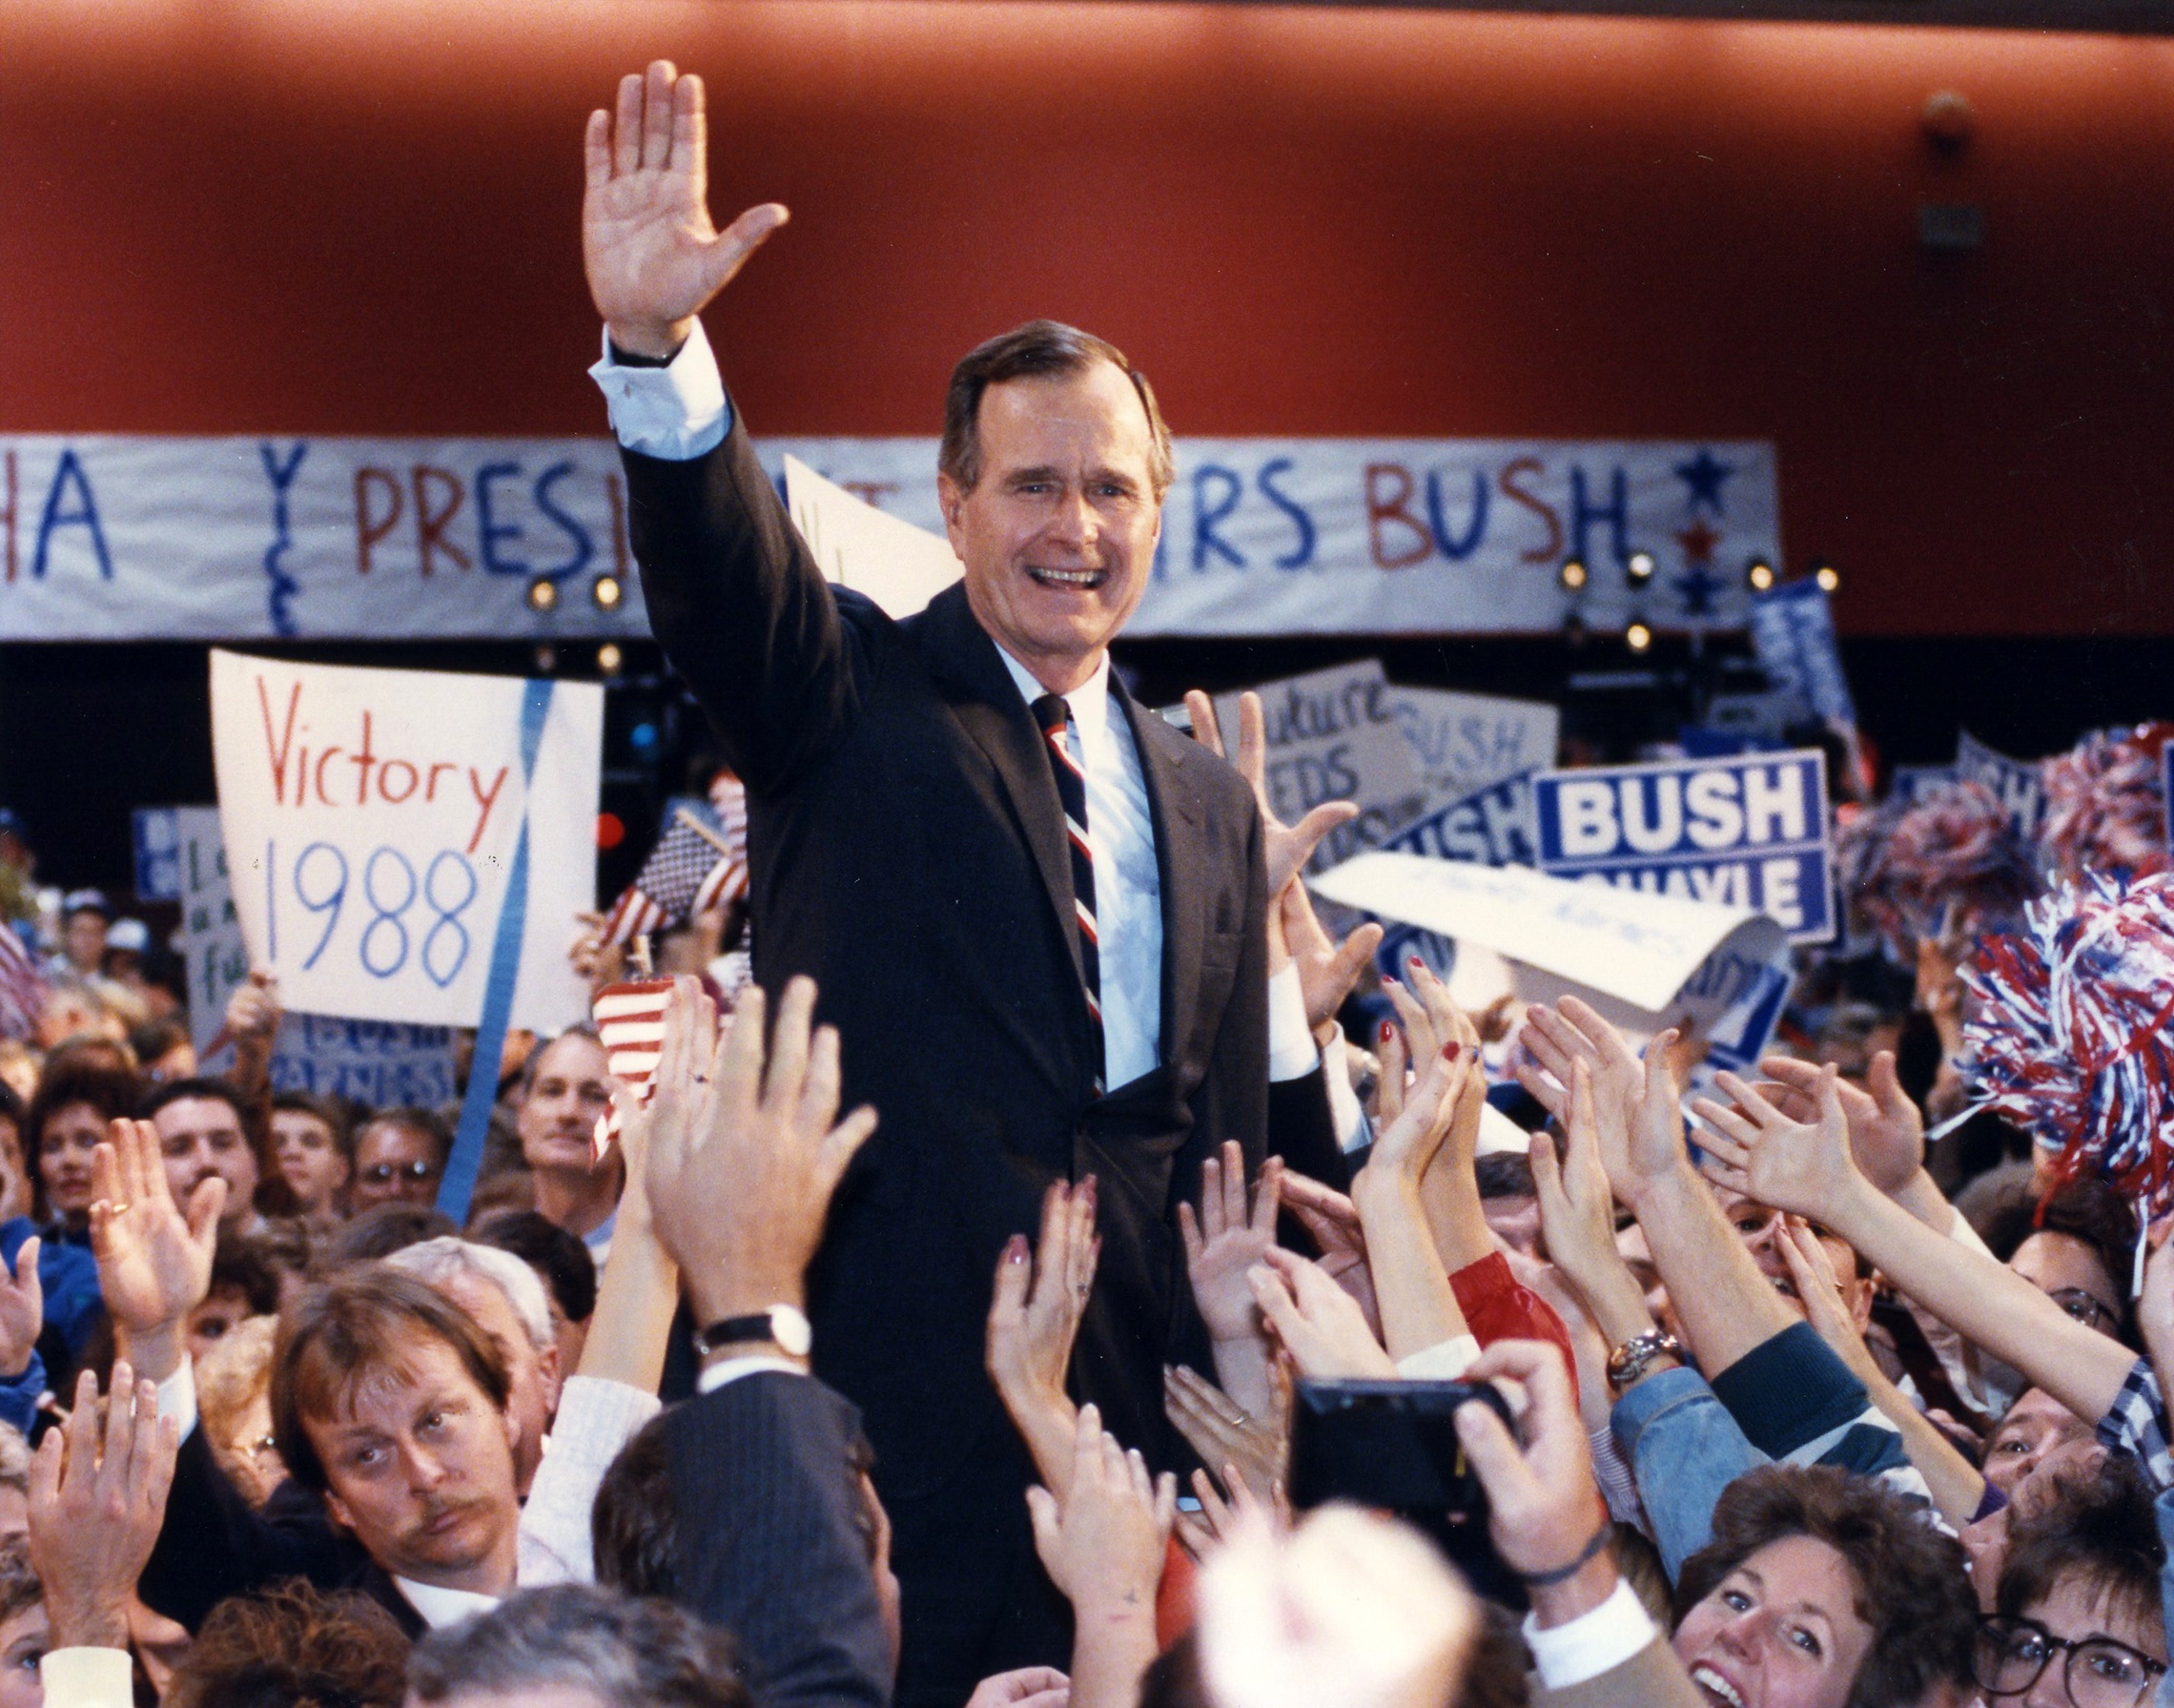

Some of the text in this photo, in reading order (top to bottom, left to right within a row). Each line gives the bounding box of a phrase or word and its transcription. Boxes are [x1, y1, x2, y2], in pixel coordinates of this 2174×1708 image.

[1154, 460, 1316, 584] RS
[1364, 458, 1630, 566] BUSH
[256, 673, 509, 854] Victory
[1265, 679, 1389, 746] uture
[1558, 763, 1806, 856] BUSH
[267, 837, 479, 989] 1988
